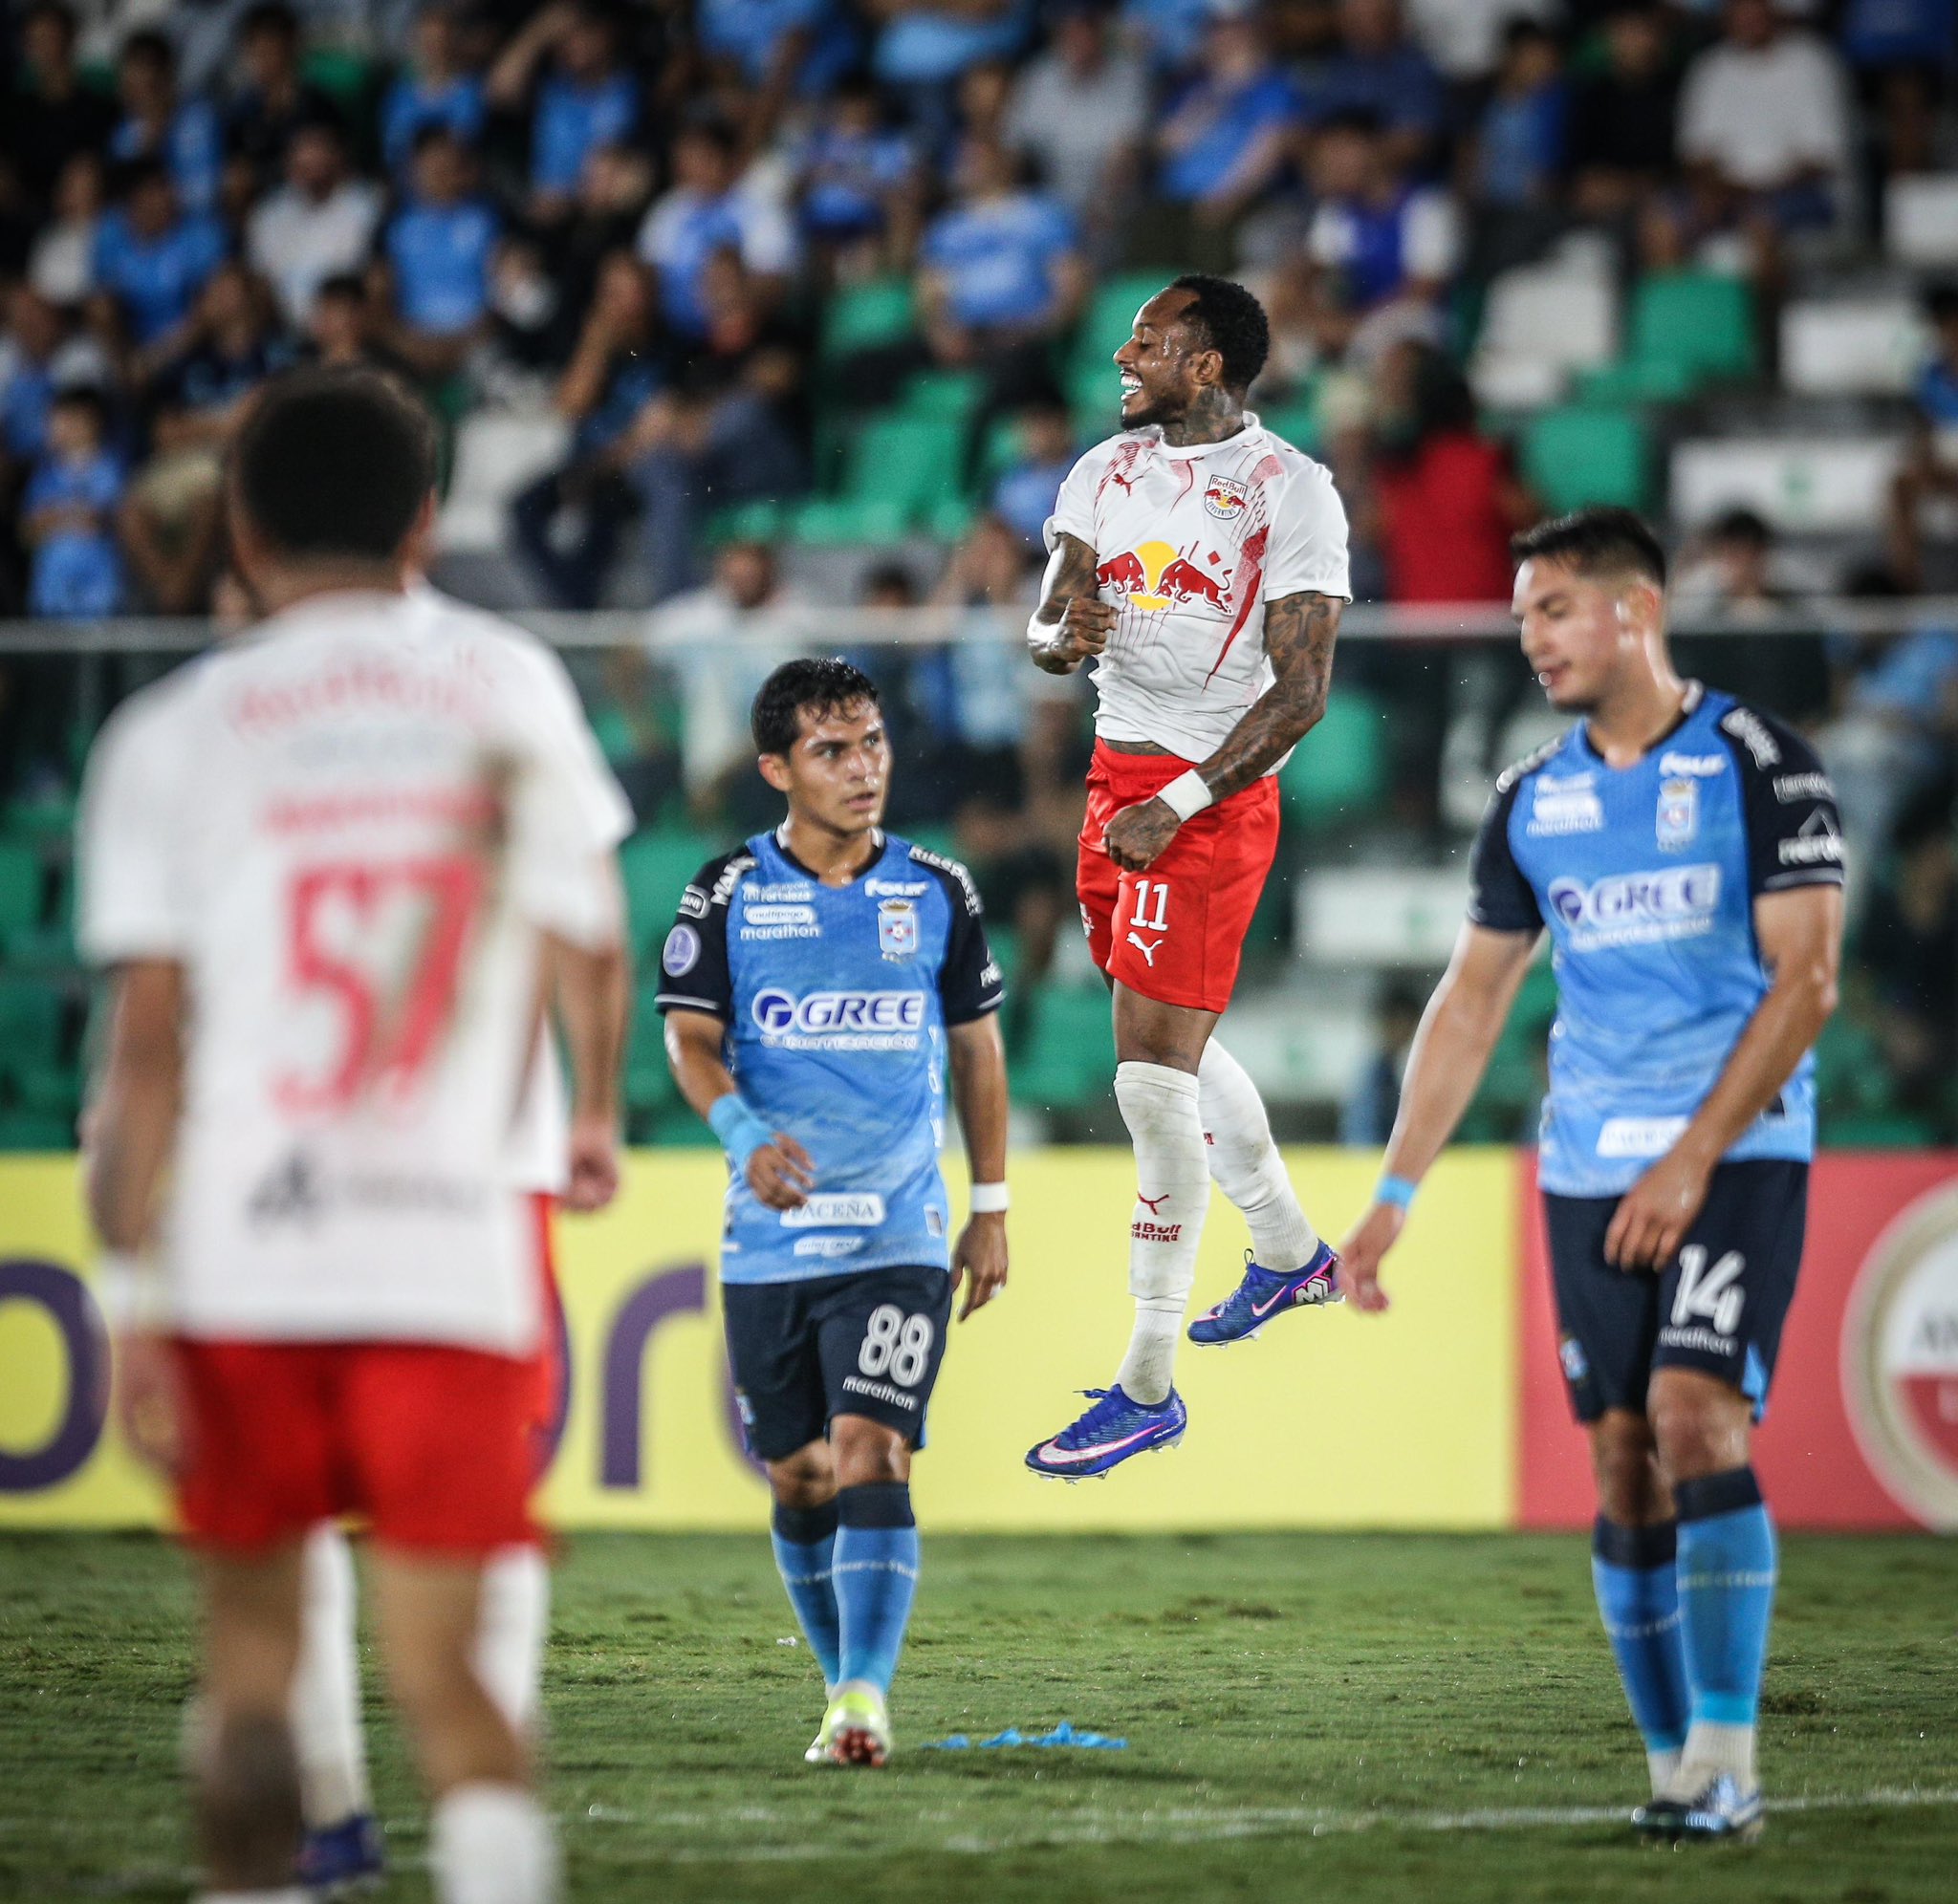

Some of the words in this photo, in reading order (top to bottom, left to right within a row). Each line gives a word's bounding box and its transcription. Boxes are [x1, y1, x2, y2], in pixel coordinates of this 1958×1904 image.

[1130, 880, 1168, 931] 11
[740, 924, 820, 941] marathon
[269, 855, 480, 1120] 57
[801, 993, 925, 1031] GREE
[1670, 1244, 1747, 1335] 14
[859, 1304, 934, 1387] 88
[842, 1376, 918, 1412] marathon
